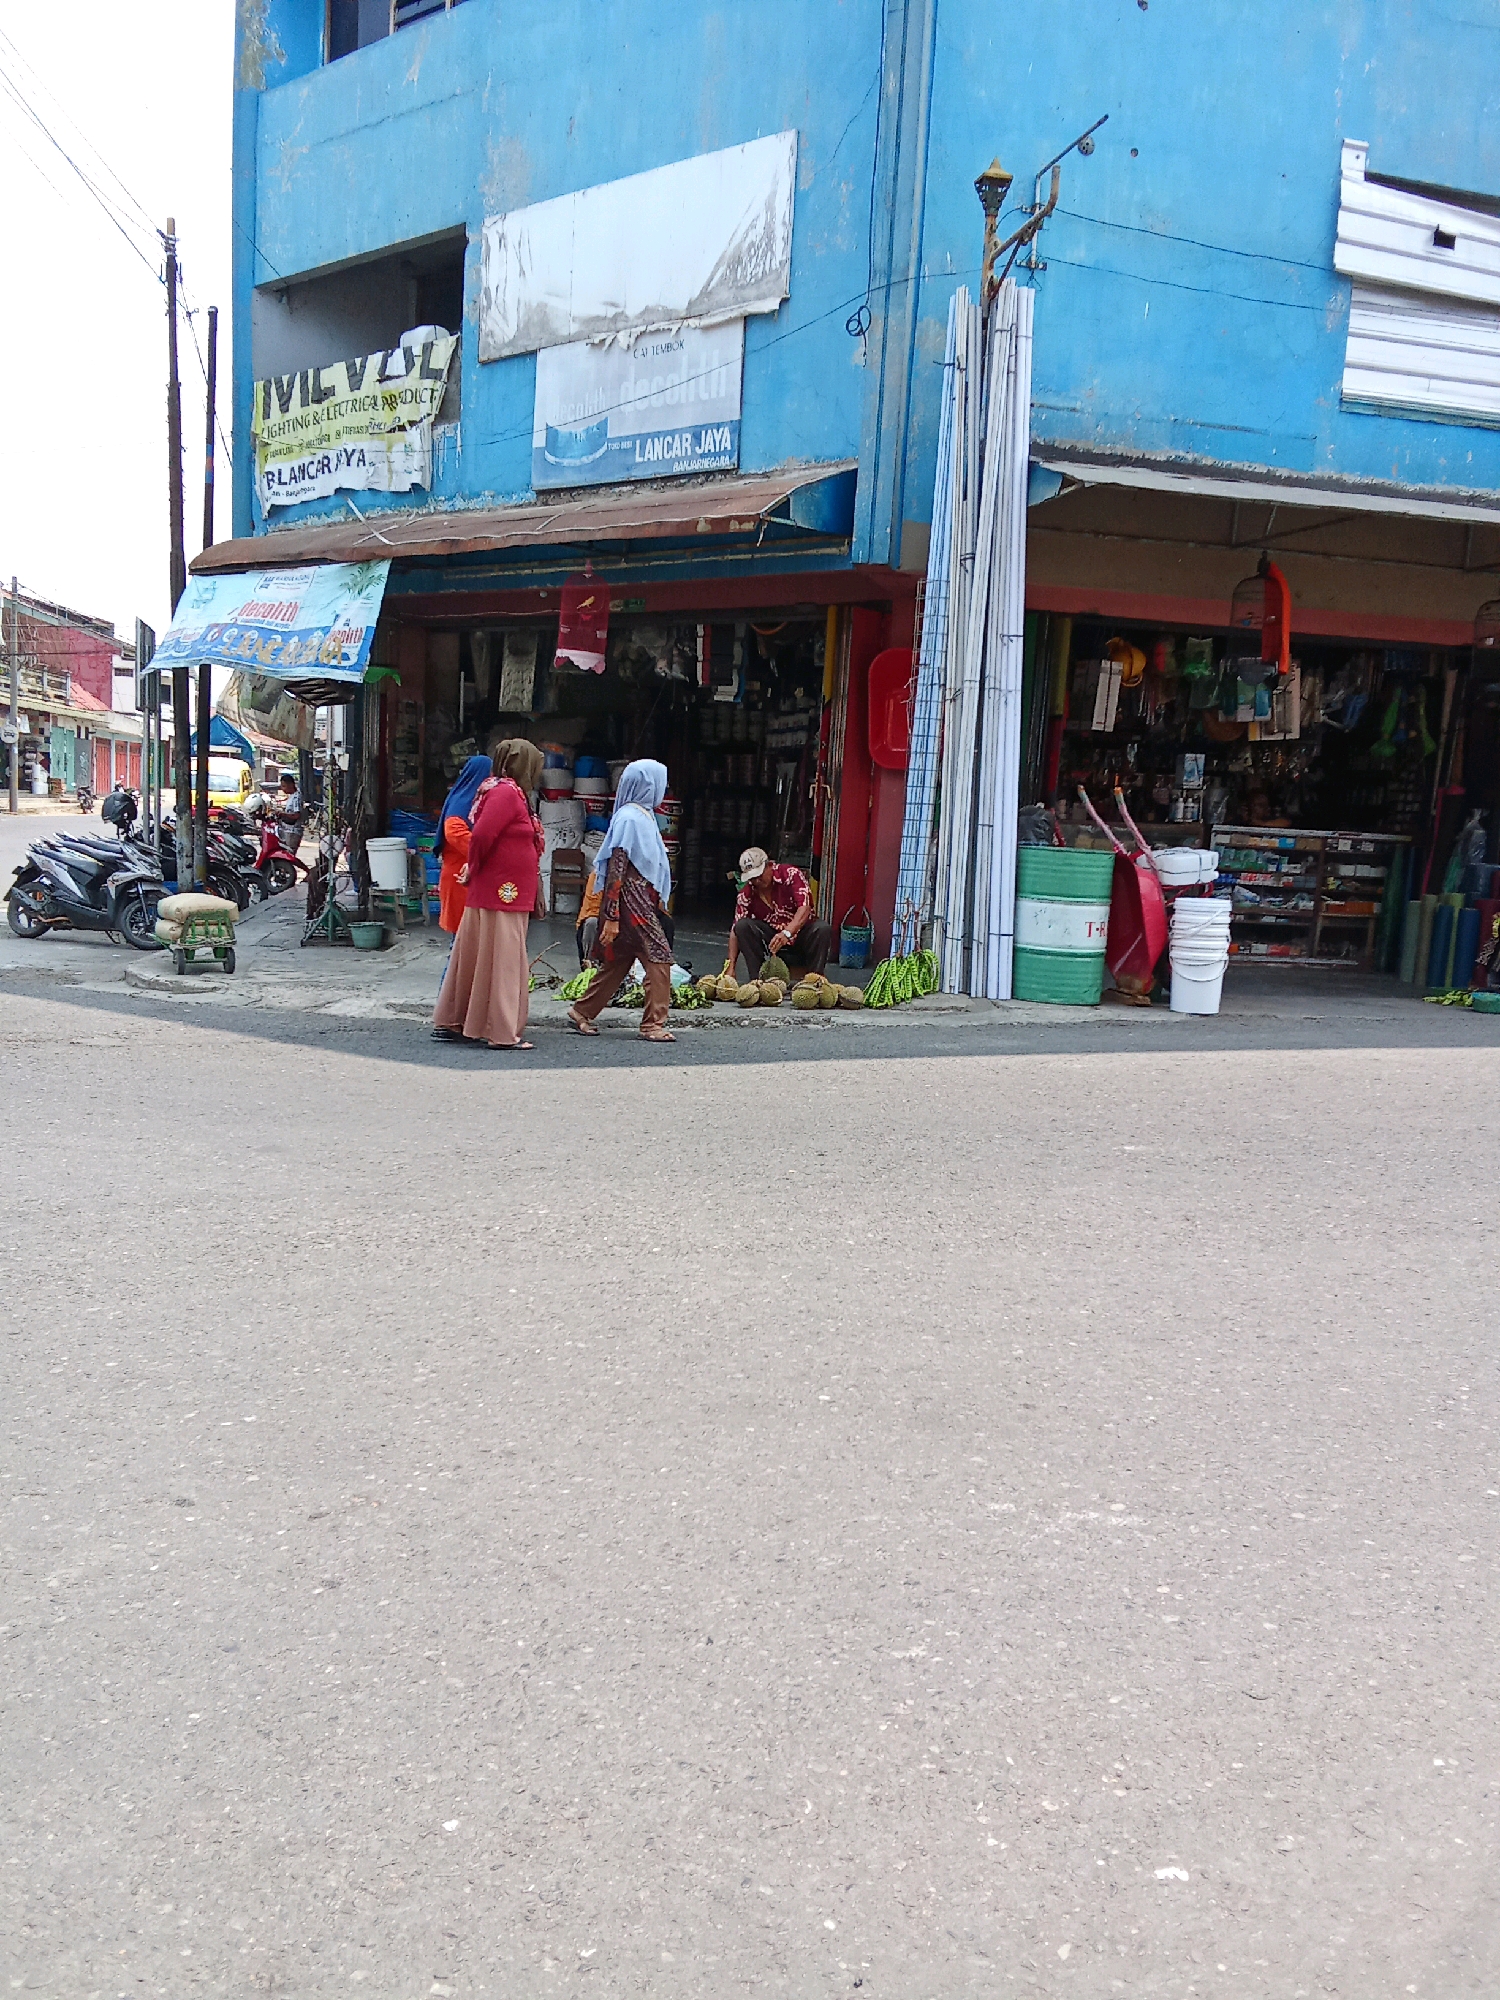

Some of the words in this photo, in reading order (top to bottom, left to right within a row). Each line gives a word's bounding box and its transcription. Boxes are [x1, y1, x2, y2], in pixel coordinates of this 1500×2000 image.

[652, 339, 684, 356] TEMBOK
[620, 350, 726, 413] decolith
[635, 432, 692, 463] LANCAR
[695, 426, 731, 454] JAYA
[672, 454, 730, 473] BANJARNEGARA
[237, 600, 299, 622] decolith
